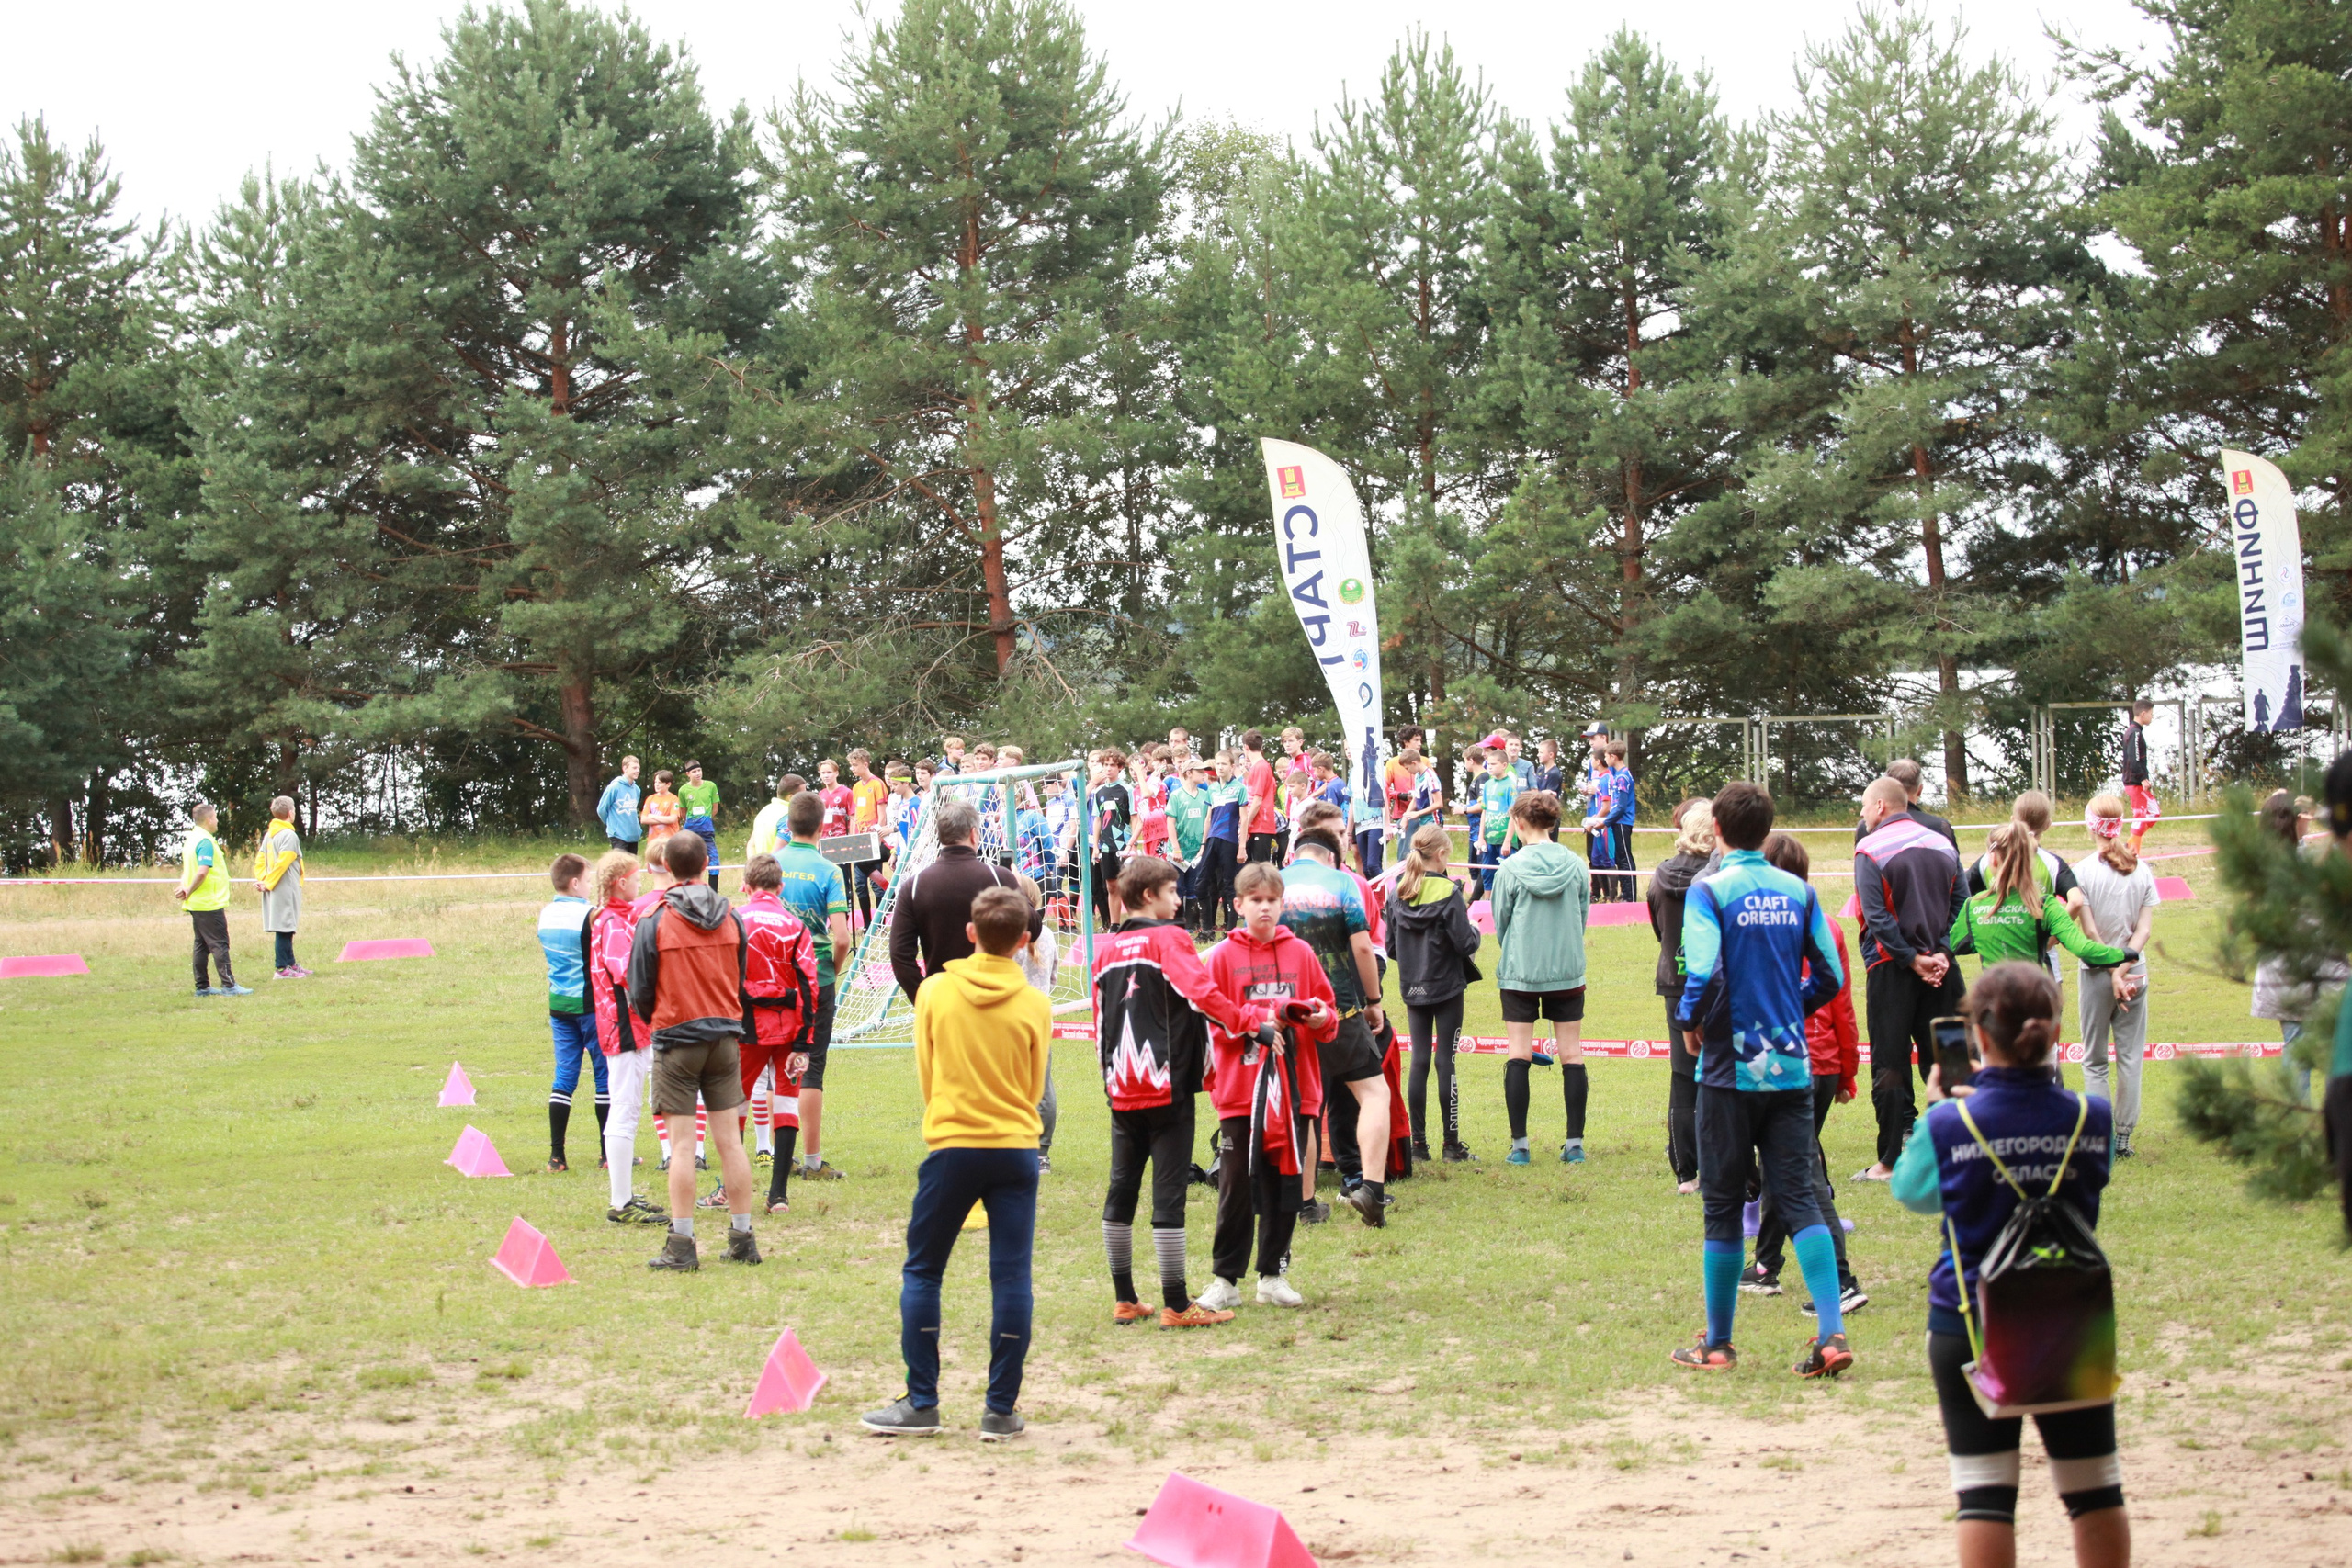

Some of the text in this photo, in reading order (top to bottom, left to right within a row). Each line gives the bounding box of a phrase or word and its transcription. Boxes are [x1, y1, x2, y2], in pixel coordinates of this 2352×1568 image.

[782, 870, 816, 882] ЫГЕЯ
[1744, 896, 1789, 910] CRAFT
[1737, 910, 1798, 926] ORIENTA
[1976, 916, 2024, 925] ОБЛАСТЬ
[1992, 1163, 2078, 1184] ОБЛАСЬ
